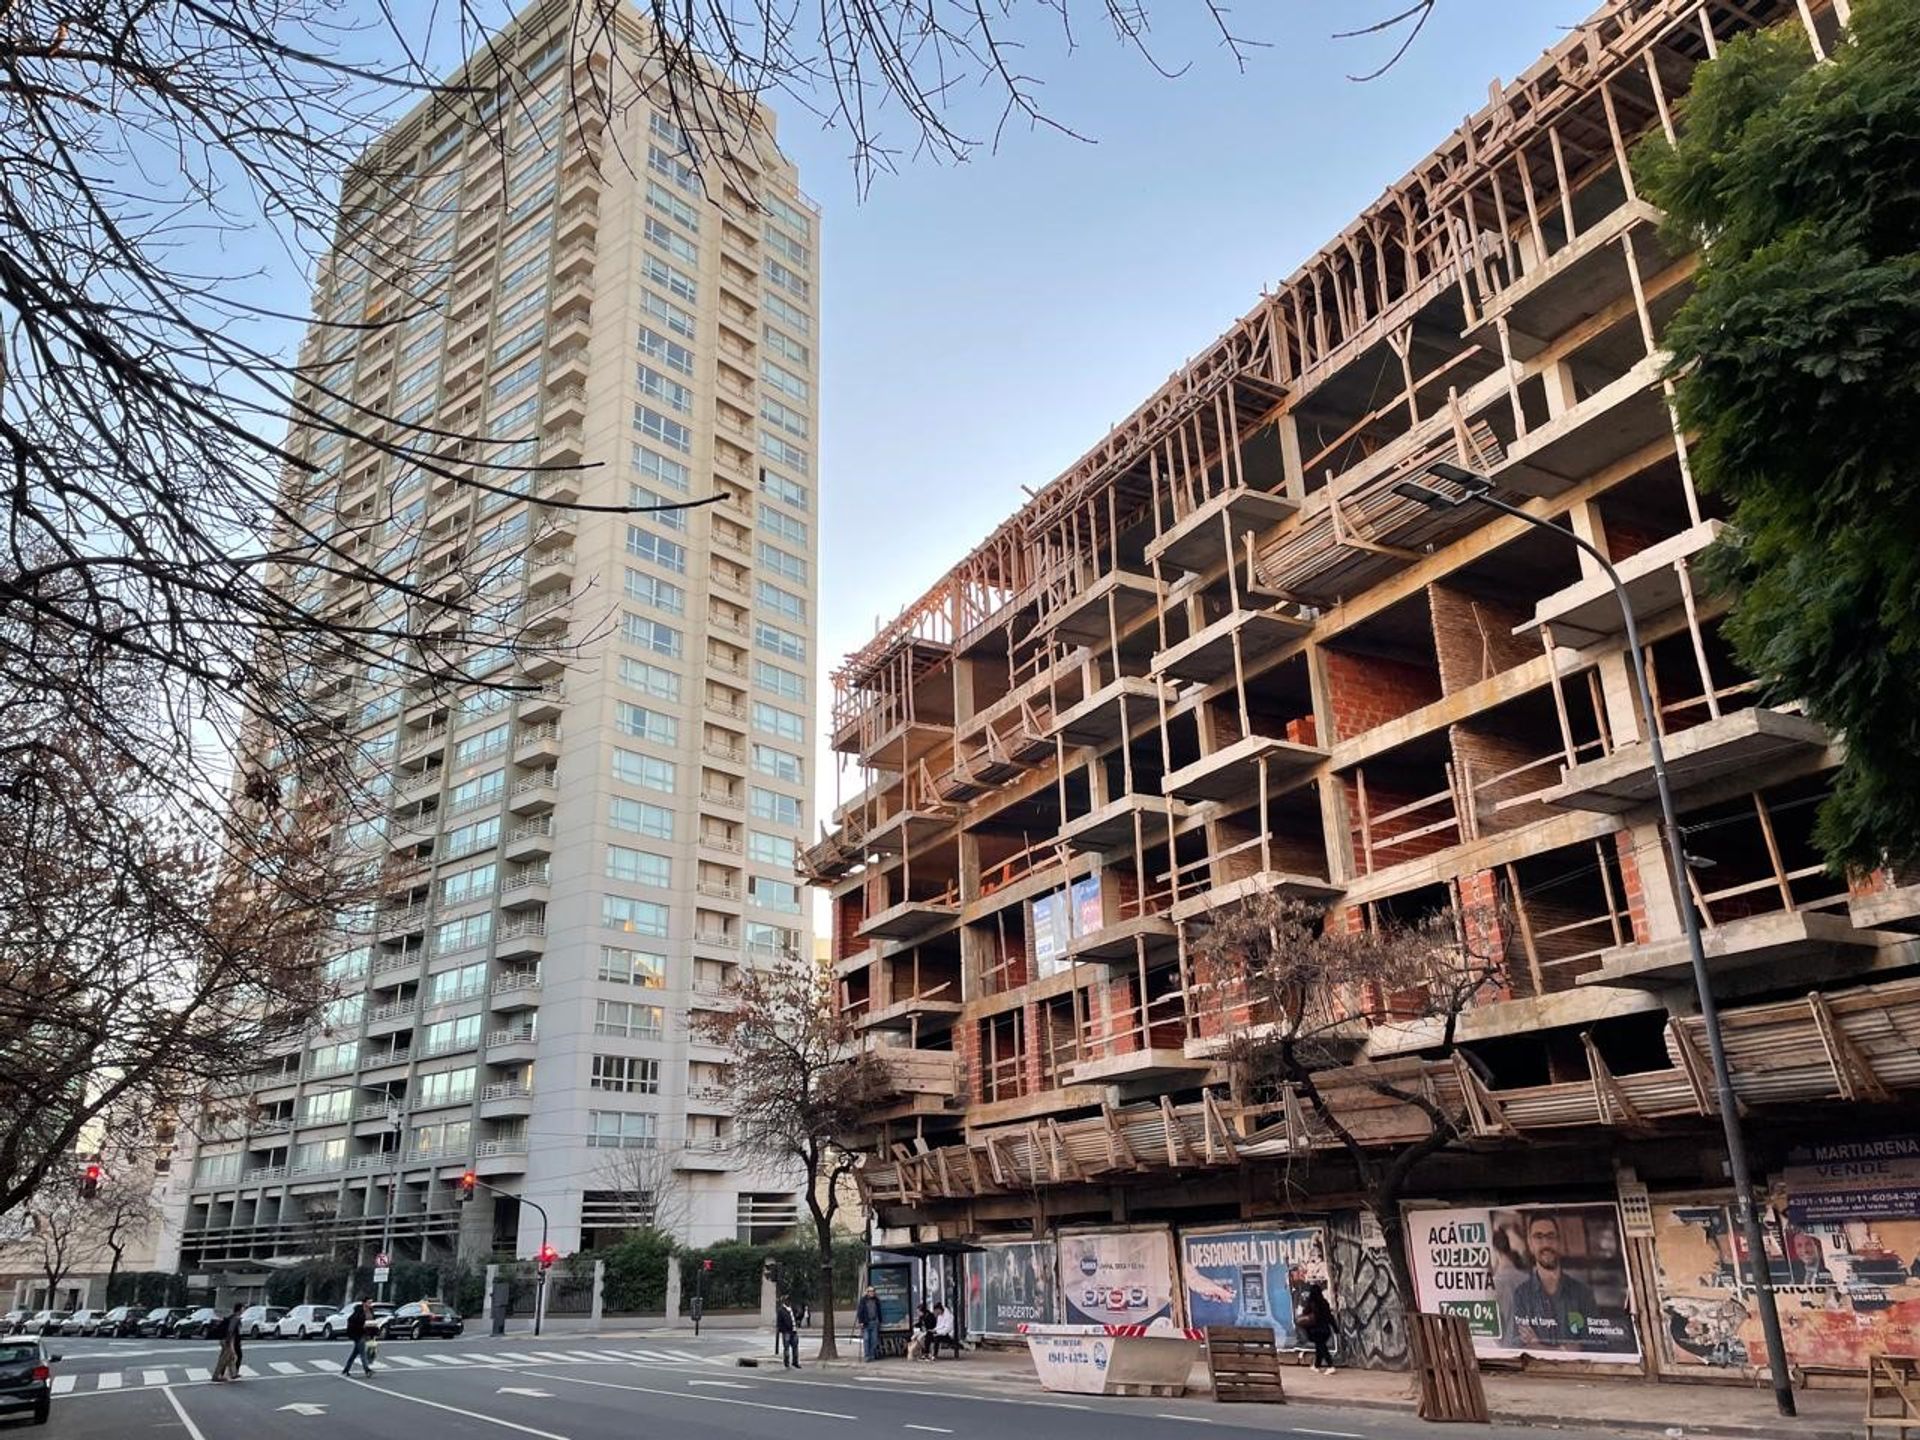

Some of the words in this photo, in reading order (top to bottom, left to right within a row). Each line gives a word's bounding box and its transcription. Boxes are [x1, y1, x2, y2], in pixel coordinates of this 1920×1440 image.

[1815, 1140, 1919, 1161] MARTIARENA
[1816, 1161, 1890, 1177] VENDE
[1428, 1221, 1458, 1244] ACÁ
[1460, 1225, 1481, 1242] TU
[1190, 1234, 1258, 1266] DESCONGELÁ
[1259, 1240, 1277, 1265] TU
[1432, 1247, 1490, 1267] SUELDO
[1435, 1272, 1496, 1290] CUENTA
[1473, 1303, 1494, 1321] 0%
[1587, 1317, 1610, 1326] Banco
[1588, 1326, 1624, 1335] Provincia
